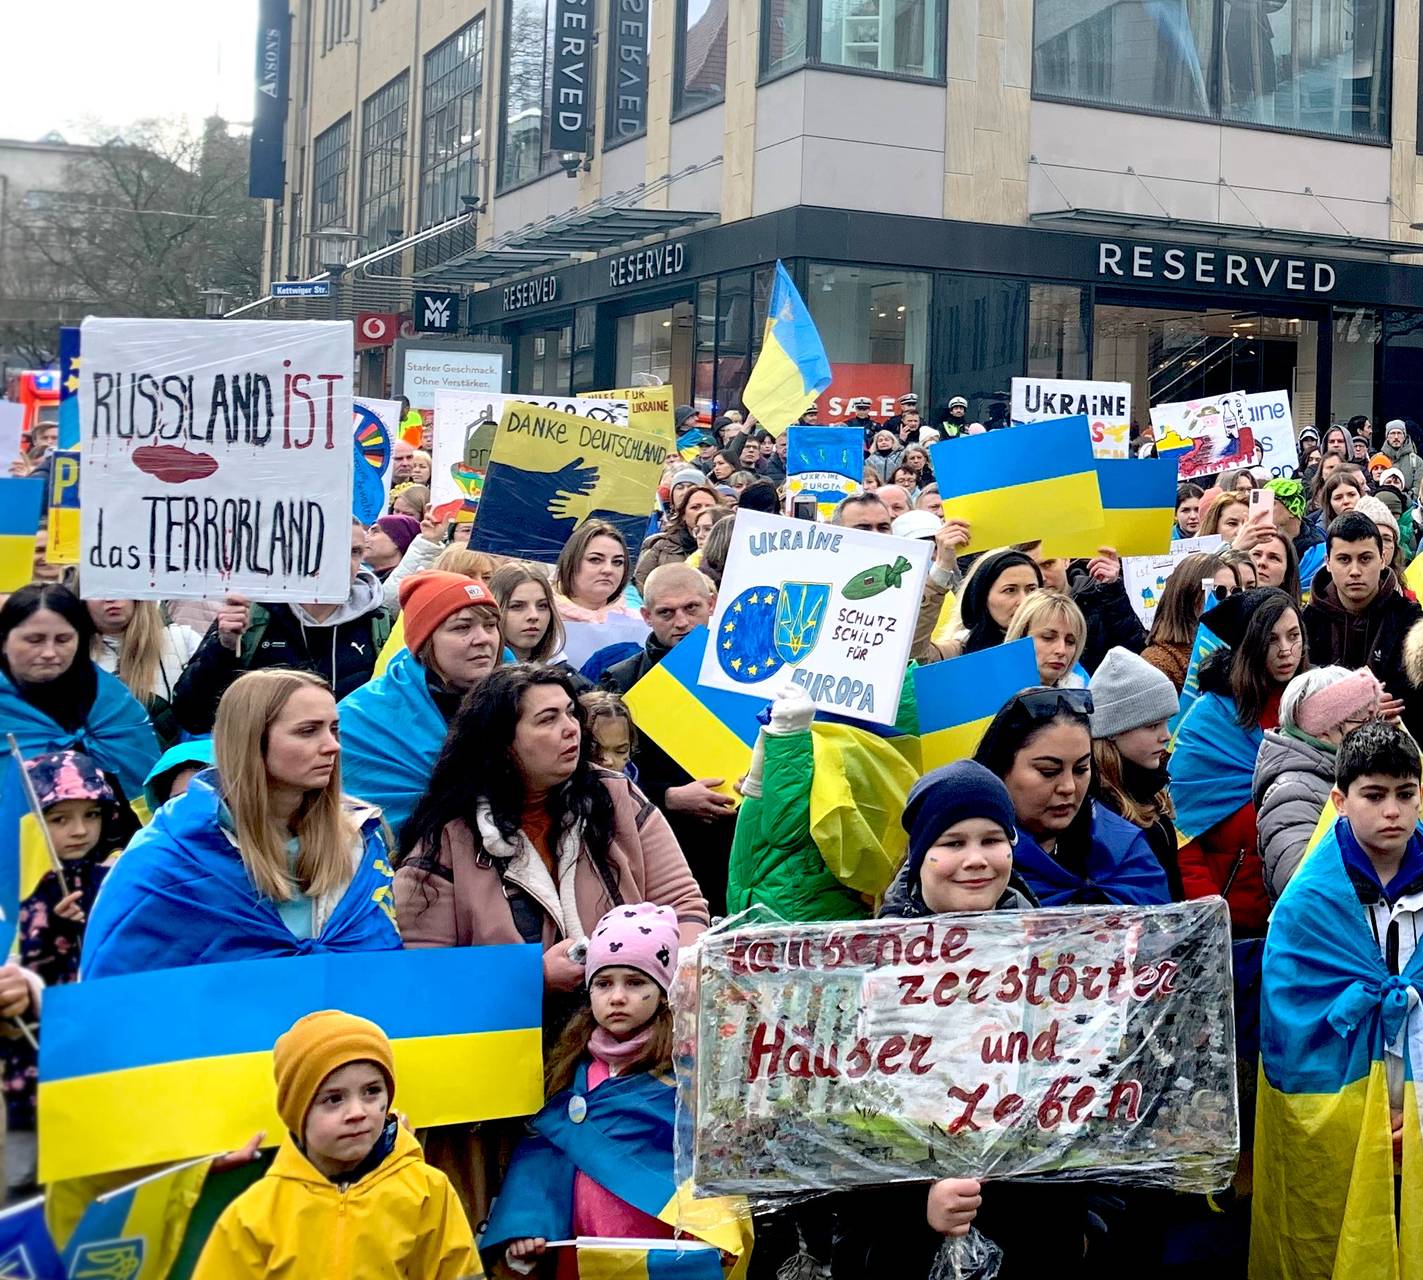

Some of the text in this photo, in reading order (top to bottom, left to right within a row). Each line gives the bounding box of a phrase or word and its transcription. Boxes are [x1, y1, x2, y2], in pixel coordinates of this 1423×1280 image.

[609, 243, 684, 288] RESERVED
[1099, 243, 1335, 292] RESERVED
[277, 285, 328, 296] Kettwiger Str.
[503, 275, 557, 312] RESERVED
[407, 362, 497, 374] Starker Geschmack.
[414, 376, 490, 388] Ohne Verstärker.
[92, 371, 274, 447] RUSSLAND
[631, 400, 669, 413] UKRAINE
[89, 496, 326, 577] das TERRORLAND
[837, 608, 897, 633] SCHUTZ
[846, 646, 868, 661] FÜR
[791, 668, 875, 713] EUROPA
[898, 953, 1179, 1008] zerstörter
[747, 1019, 1063, 1083] Häuser und
